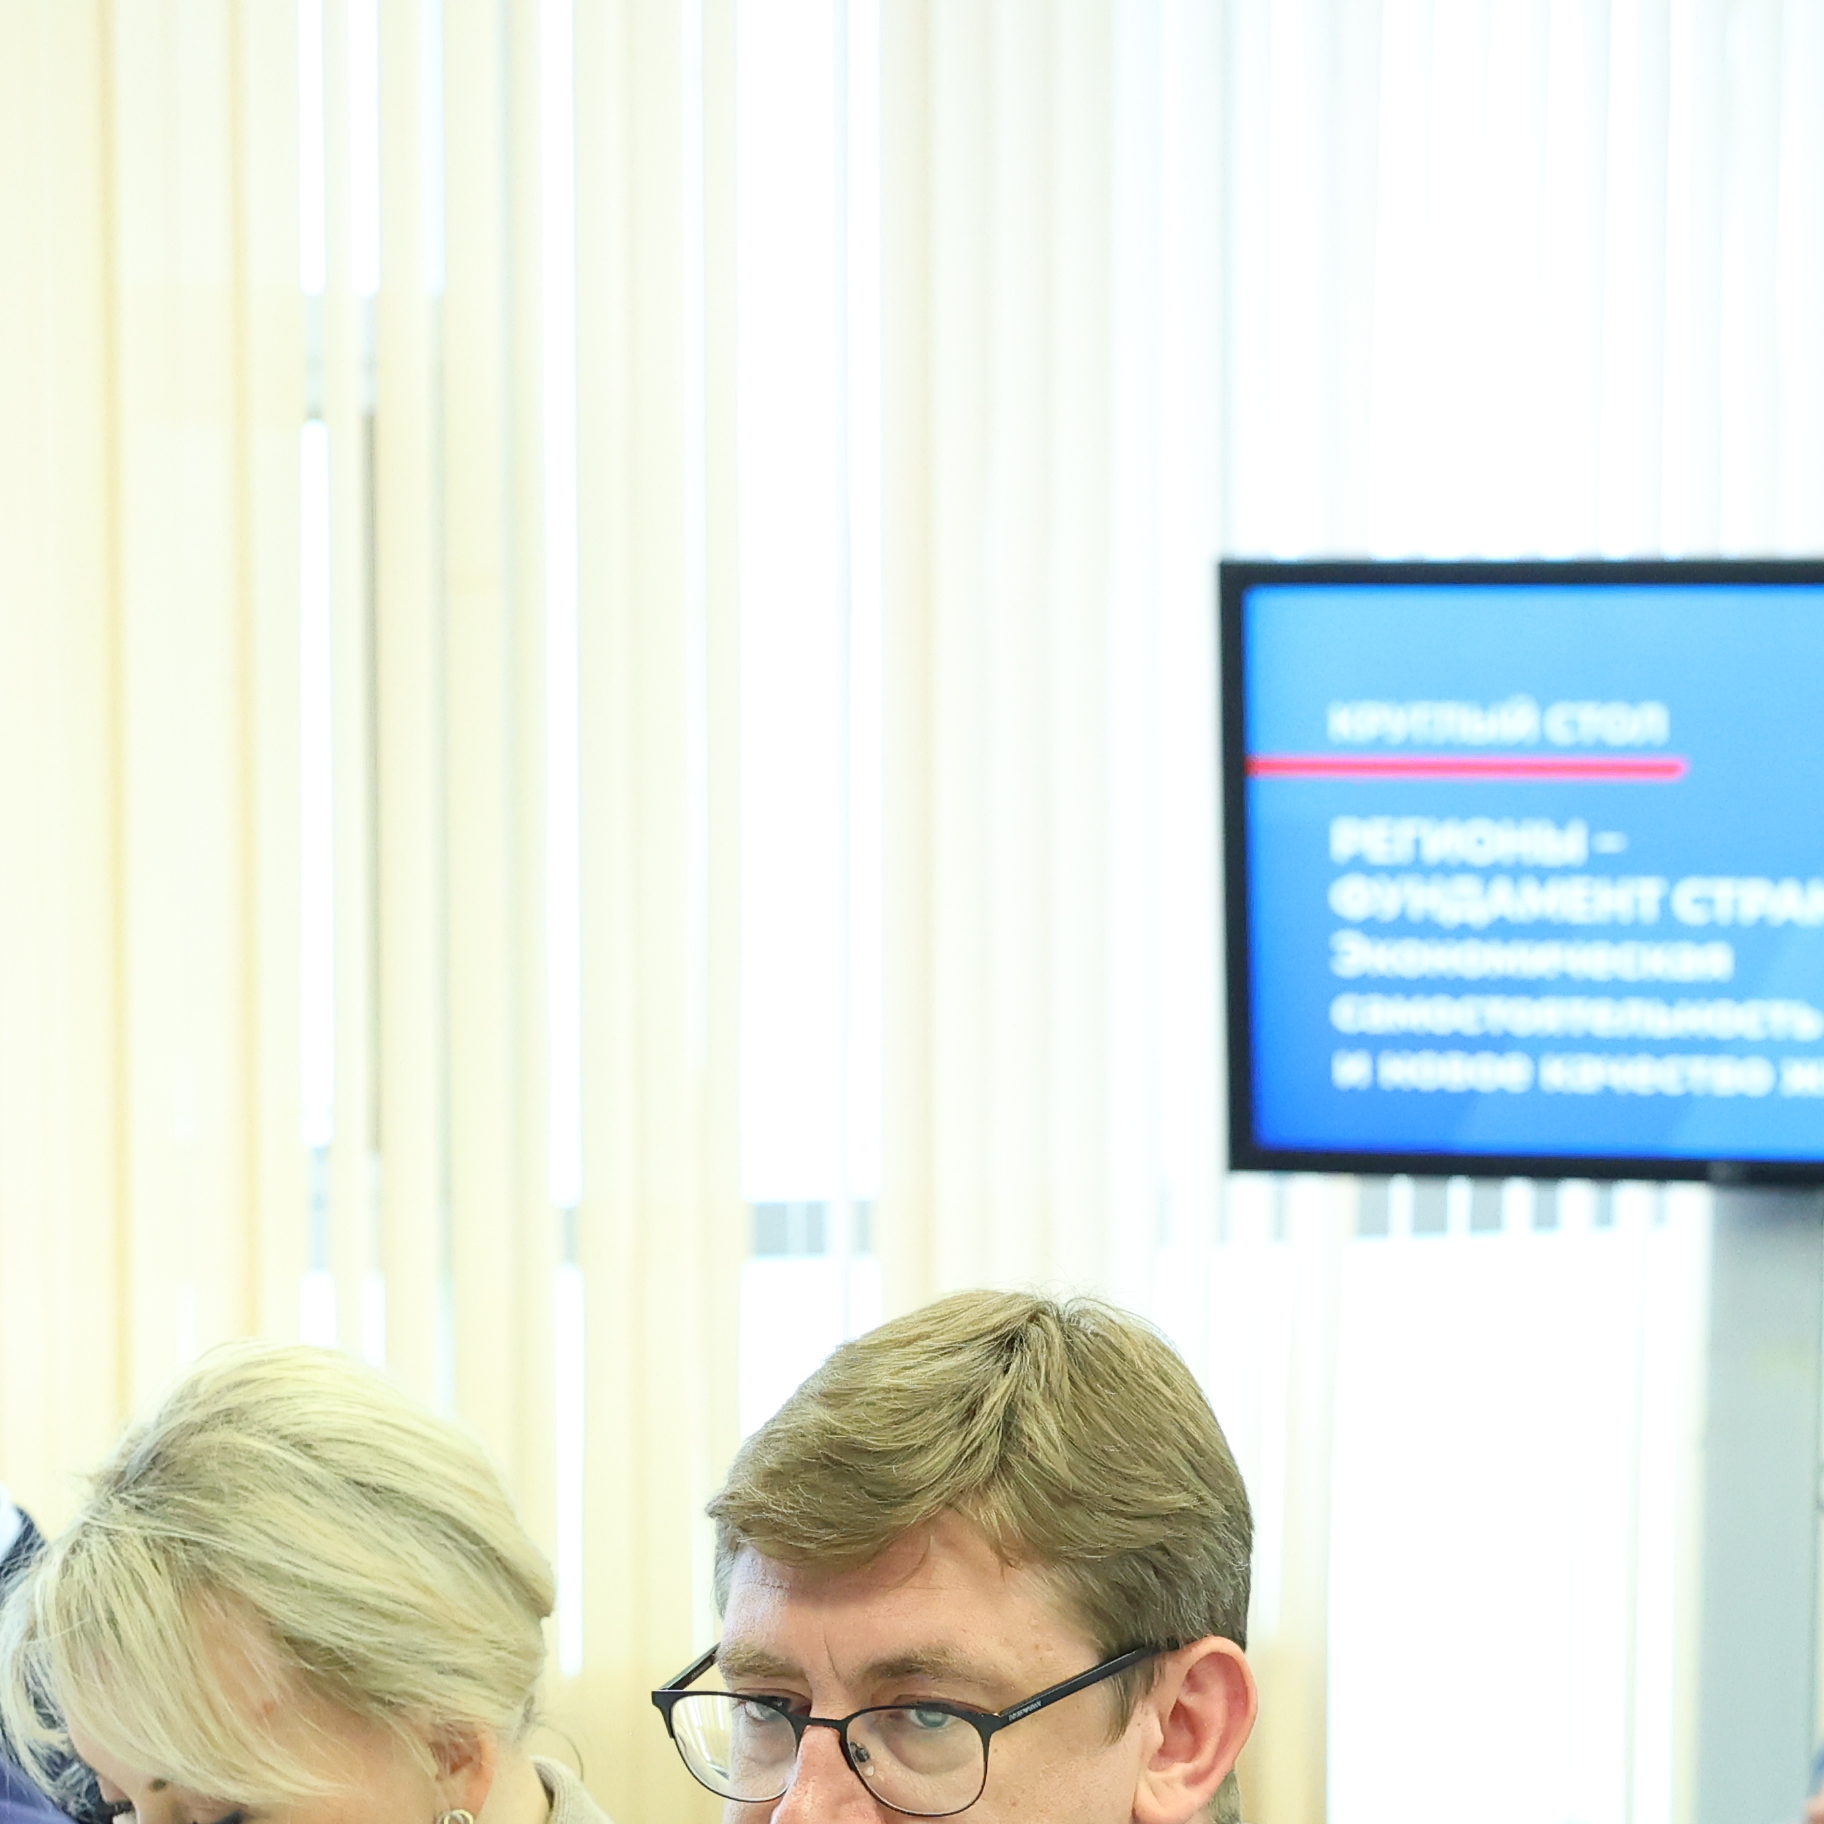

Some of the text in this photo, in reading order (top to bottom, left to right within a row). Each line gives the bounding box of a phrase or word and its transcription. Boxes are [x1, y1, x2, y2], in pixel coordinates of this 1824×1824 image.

[1328, 694, 1670, 746] КРУГЛЫЙ СТОЛ
[1330, 817, 1588, 867] РЕГИОНЫ
[1329, 875, 1668, 926] ФУНДАМЕНТ
